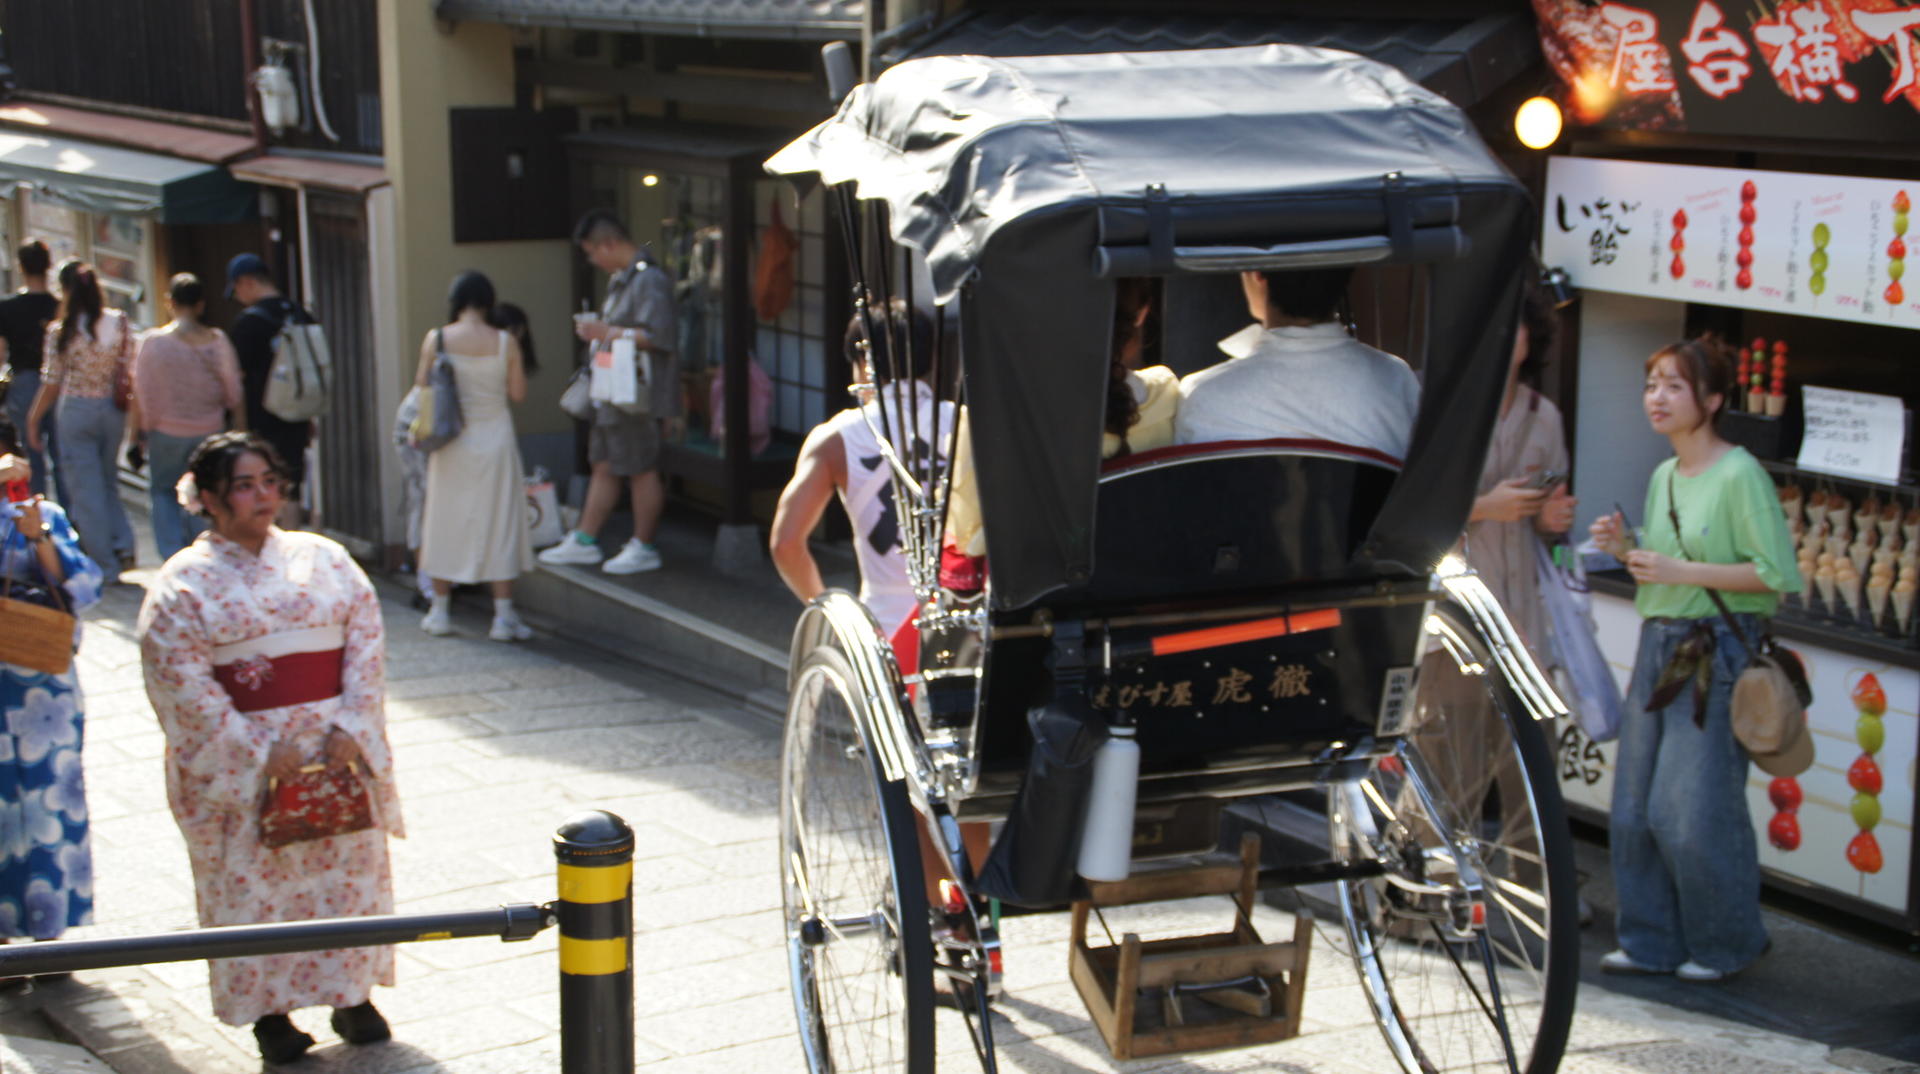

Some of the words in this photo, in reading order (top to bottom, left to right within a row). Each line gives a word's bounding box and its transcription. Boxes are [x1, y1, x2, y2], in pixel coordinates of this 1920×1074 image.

[1601, 0, 1920, 103] 屋台横丁
[1555, 194, 1641, 236] いちご
[1589, 229, 1621, 267] 飴
